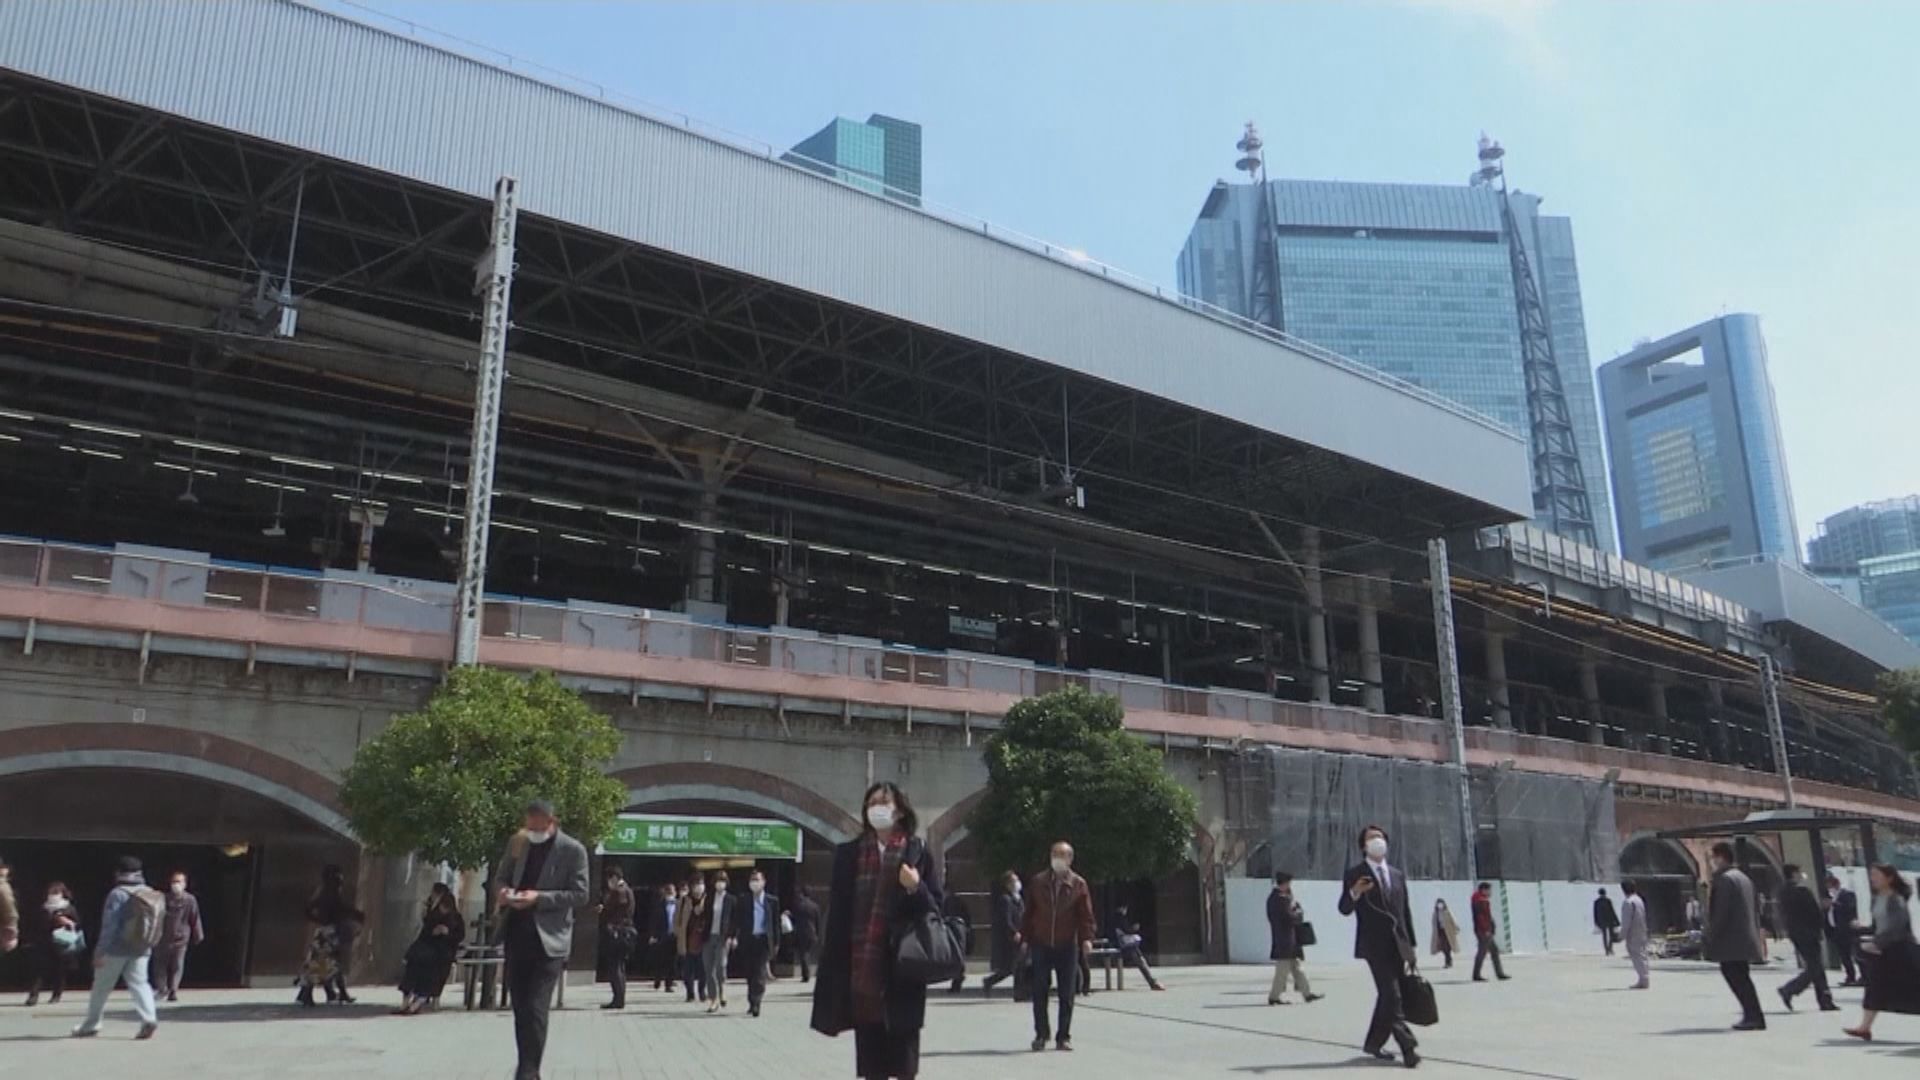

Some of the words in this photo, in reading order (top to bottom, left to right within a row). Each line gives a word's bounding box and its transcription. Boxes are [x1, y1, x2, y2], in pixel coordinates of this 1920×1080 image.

[618, 827, 637, 843] JR
[647, 825, 689, 840] 新橋駅
